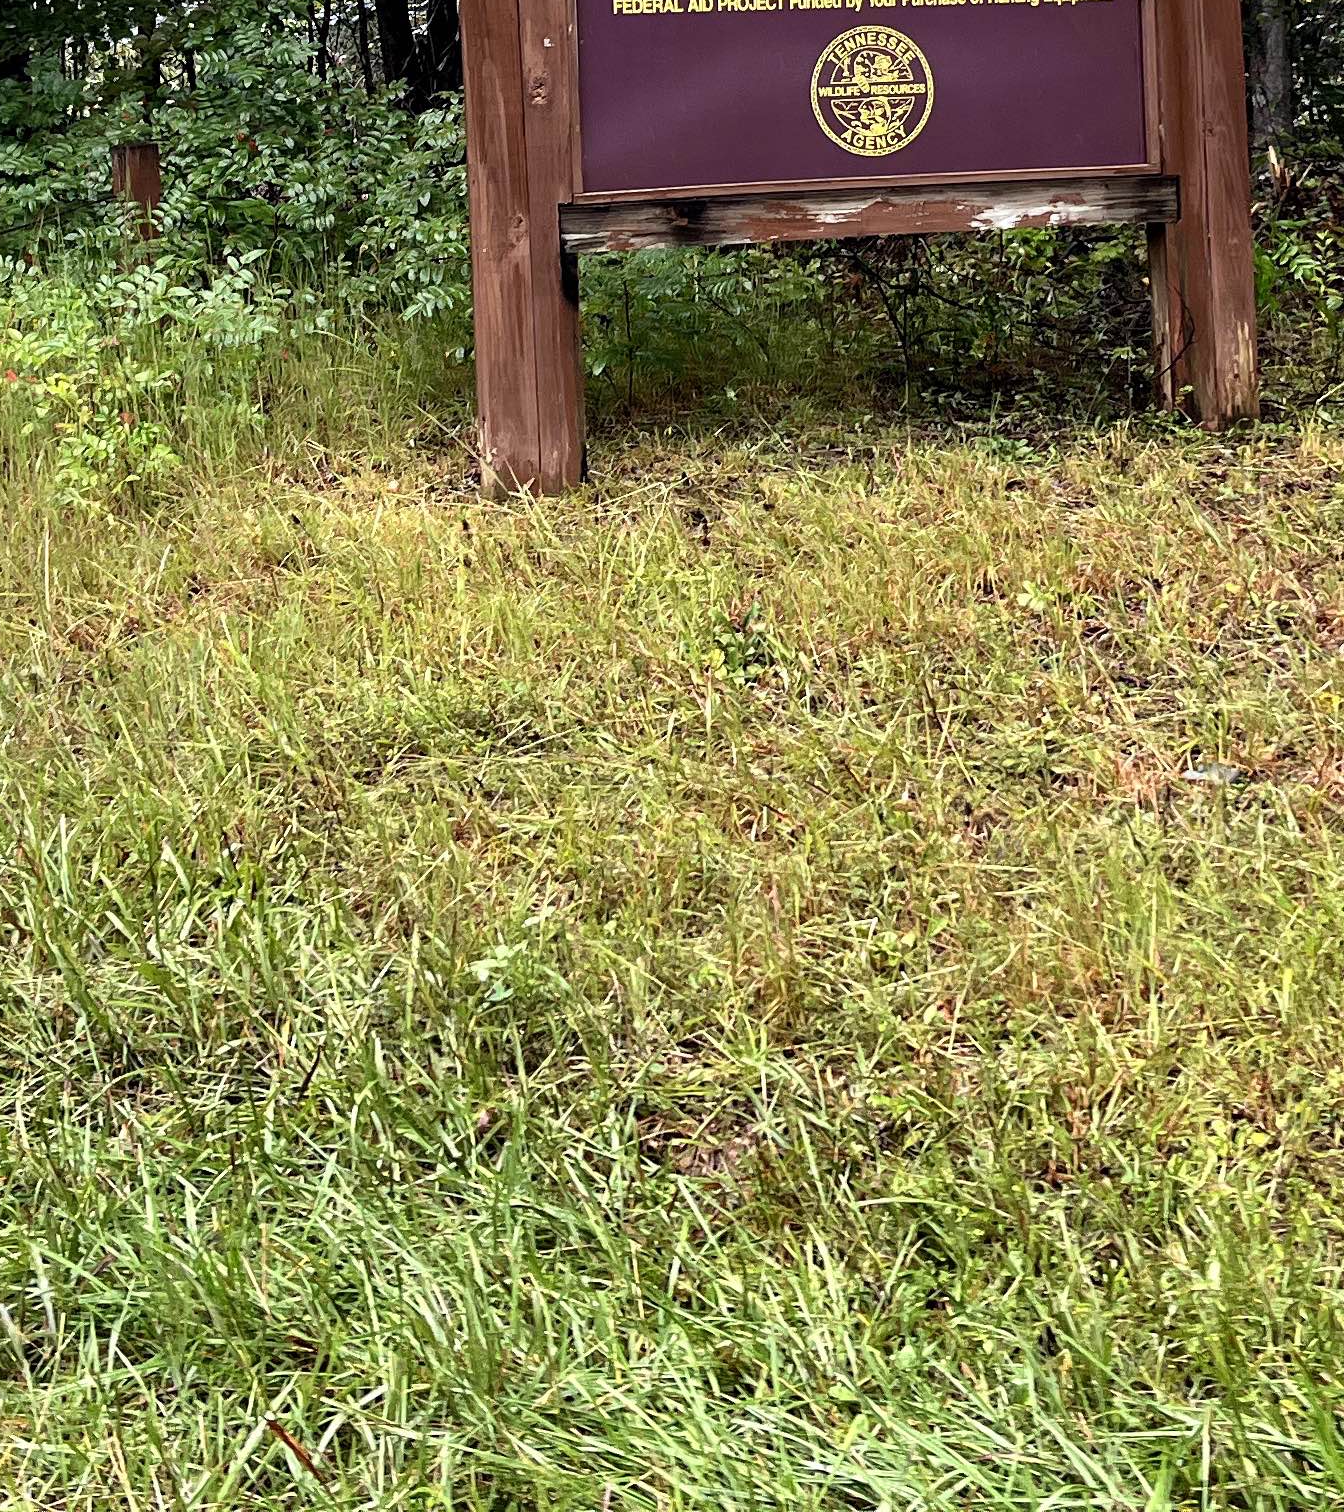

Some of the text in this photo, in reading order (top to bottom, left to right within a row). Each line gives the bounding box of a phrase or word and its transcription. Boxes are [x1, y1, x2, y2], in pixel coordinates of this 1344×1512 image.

[827, 32, 916, 65] TENNESSEE
[818, 84, 926, 97] WILDLIFE RESOURCES
[841, 125, 907, 149] AGENCY
